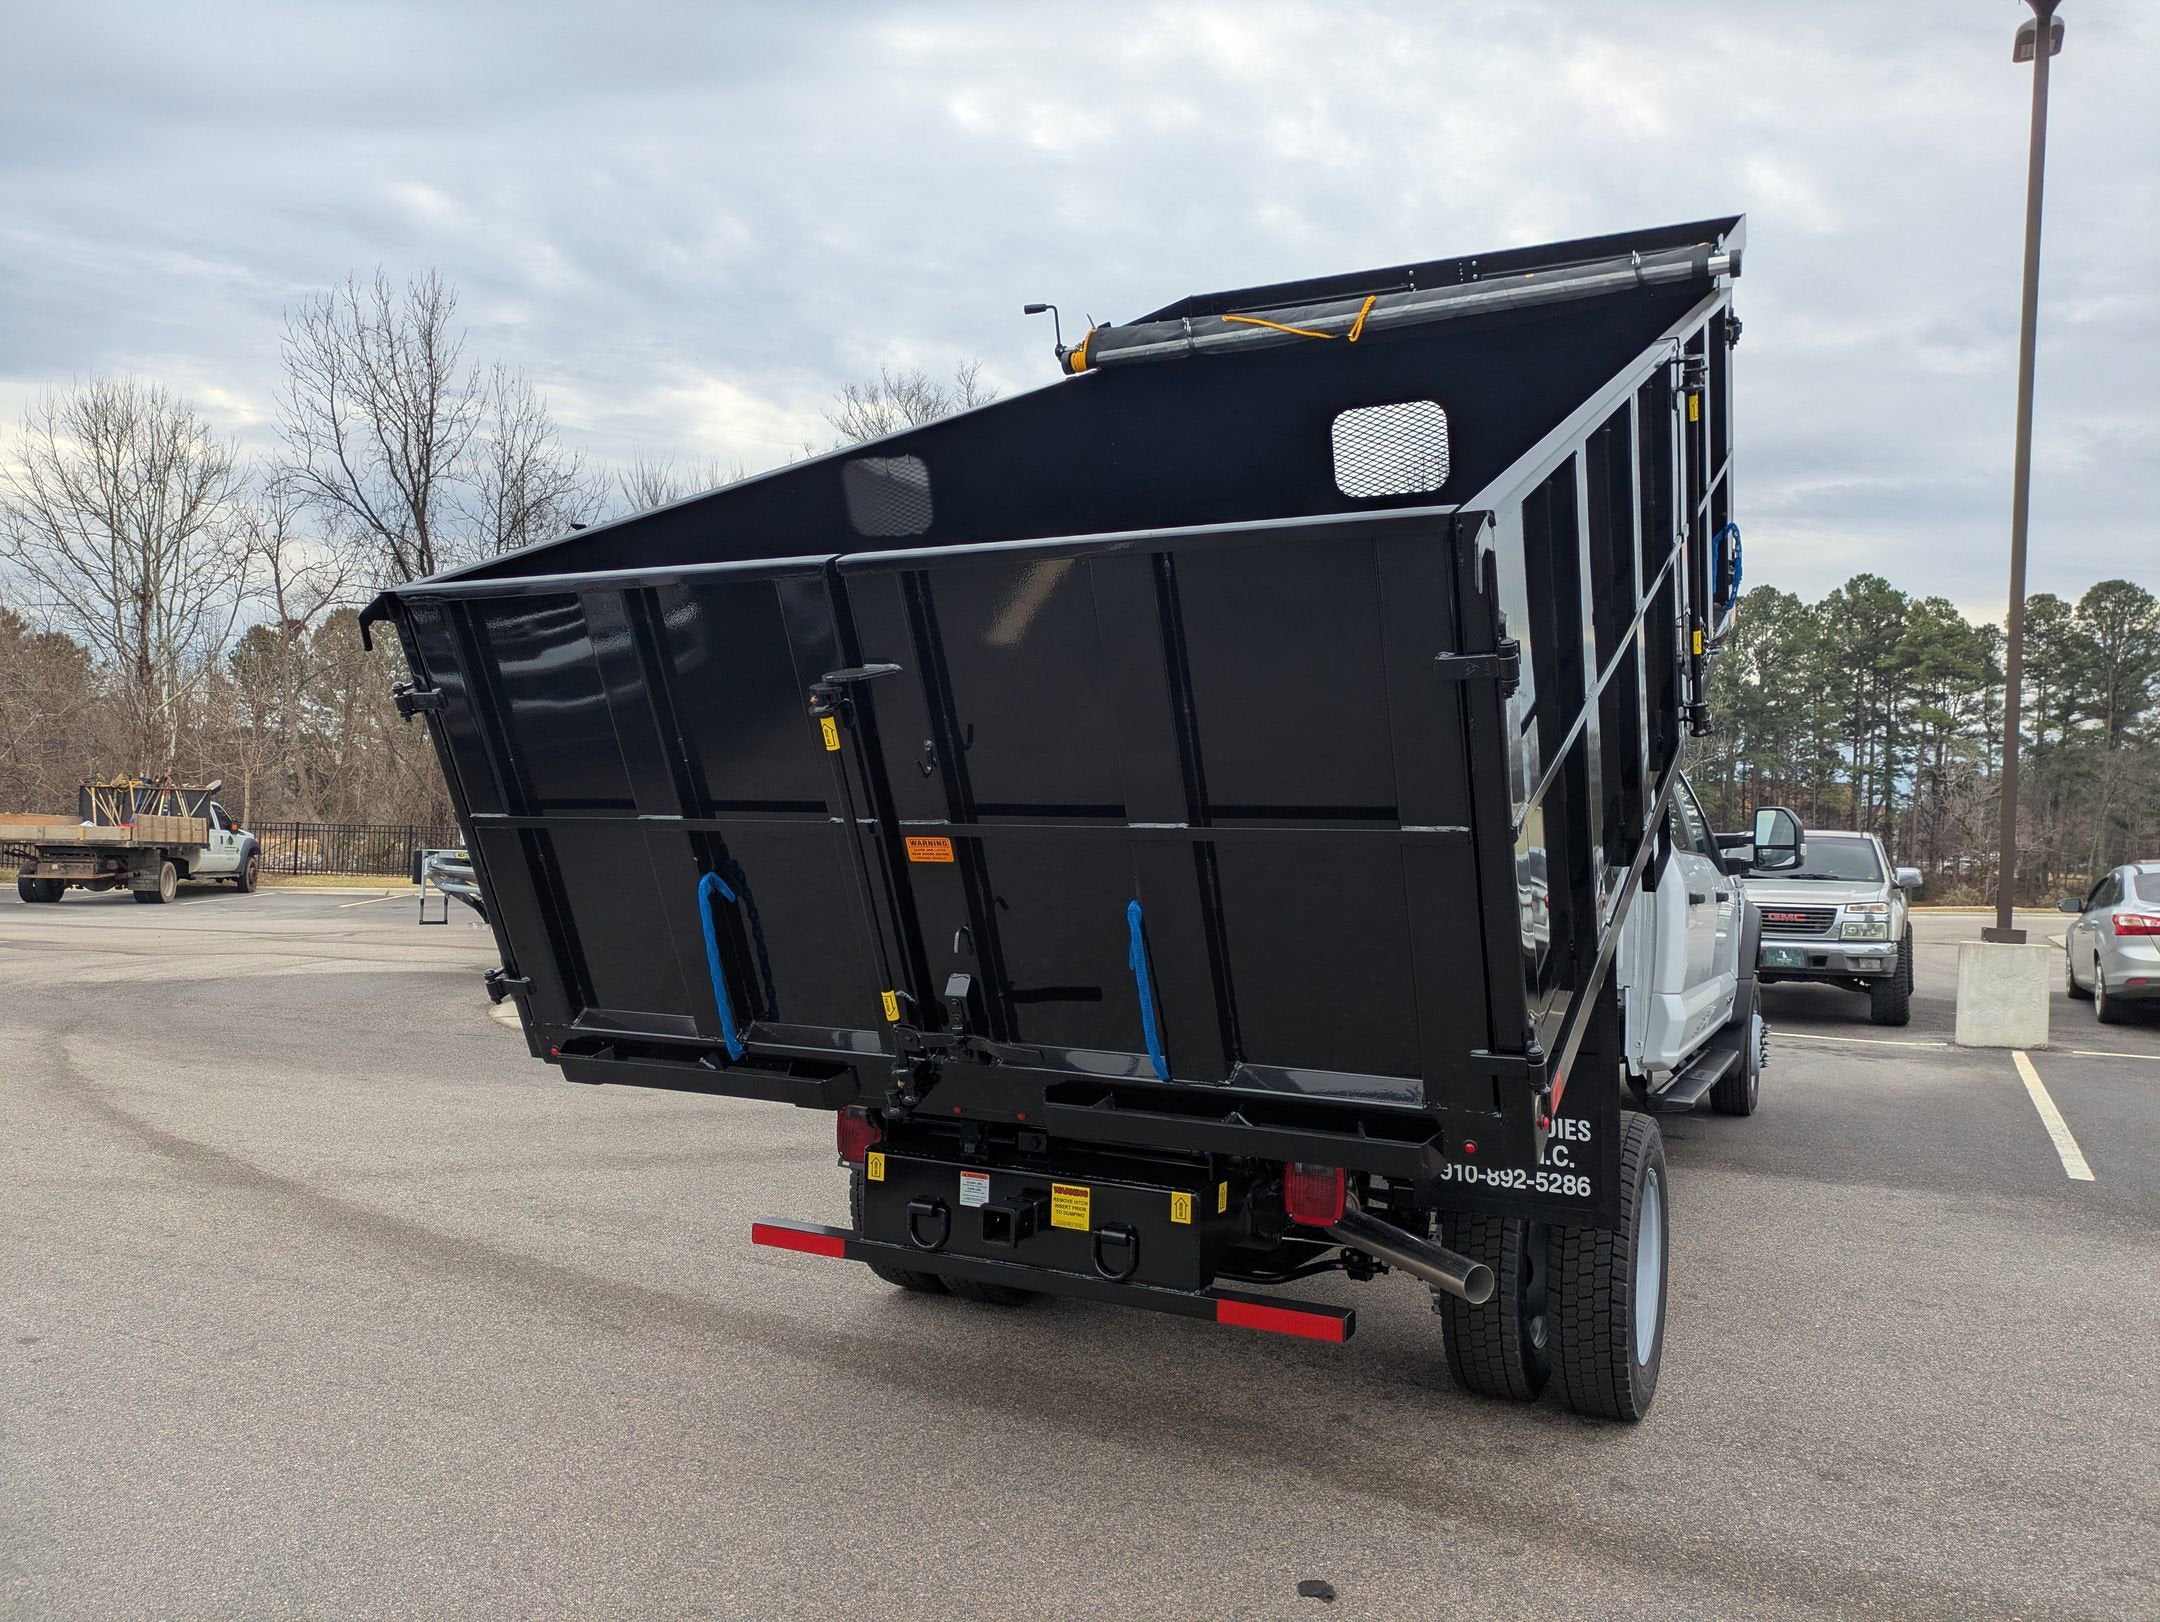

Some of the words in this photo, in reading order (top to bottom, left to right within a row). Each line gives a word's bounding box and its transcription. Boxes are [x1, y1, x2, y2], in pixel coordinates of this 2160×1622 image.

[1768, 913, 1806, 921] GMC
[1539, 1145, 1575, 1168] .C.
[1440, 1163, 1592, 1197] 910-892-5286
[1053, 1185, 1088, 1198] WARNING
